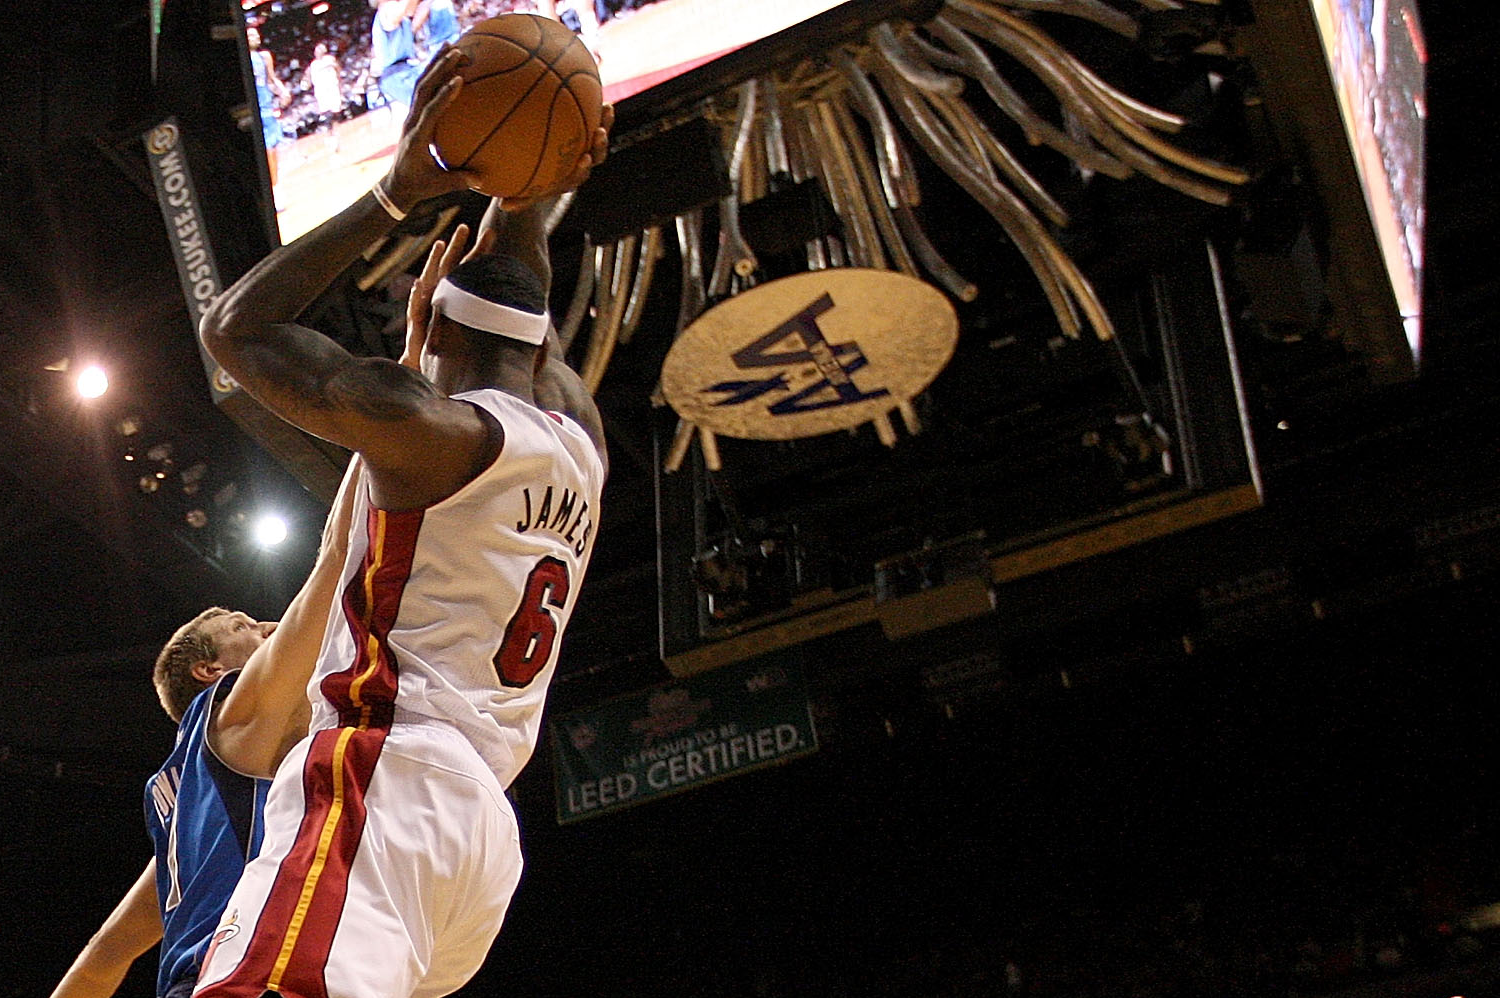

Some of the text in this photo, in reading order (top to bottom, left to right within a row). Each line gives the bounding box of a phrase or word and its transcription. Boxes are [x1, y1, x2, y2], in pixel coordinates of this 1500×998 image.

[157, 151, 219, 315] COSUKEE.COM
[516, 485, 593, 559] JAMES
[492, 554, 571, 689] 6
[566, 723, 805, 813] LEED CERTIFIED.
